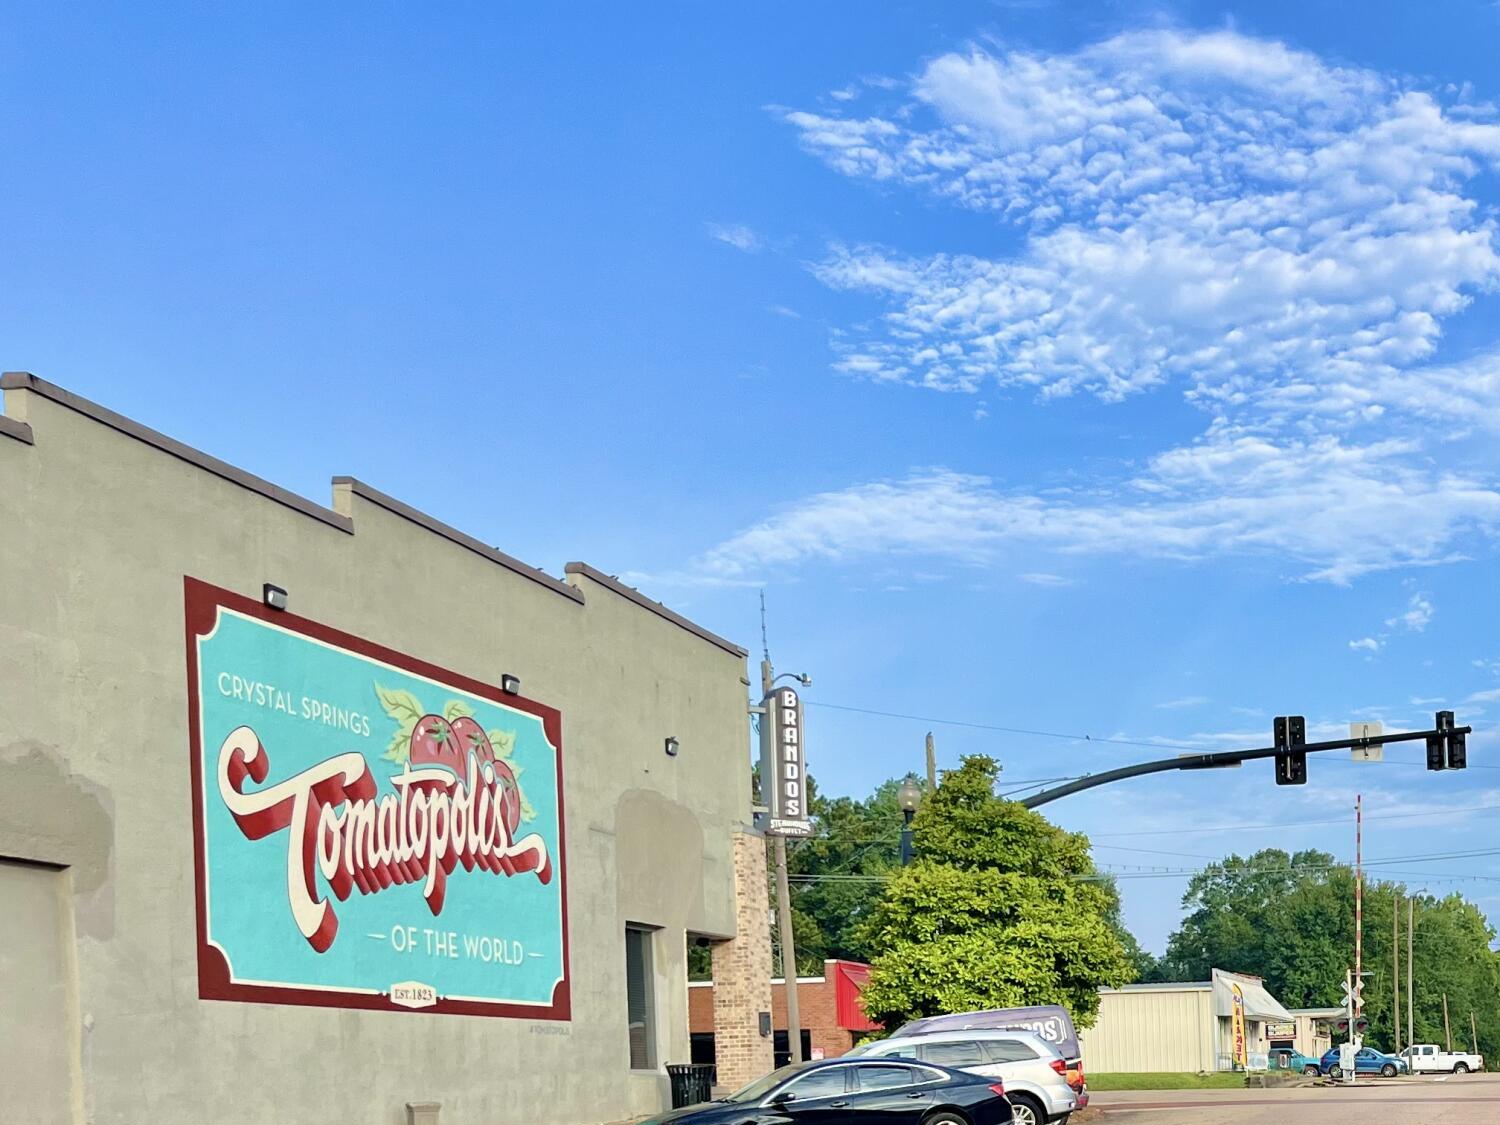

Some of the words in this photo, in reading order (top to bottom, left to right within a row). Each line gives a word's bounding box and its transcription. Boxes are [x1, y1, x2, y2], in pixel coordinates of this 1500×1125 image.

[218, 672, 297, 716] CRYSTAL
[302, 697, 370, 737] SPRINGS
[781, 690, 800, 816] BRANDOS
[217, 726, 552, 952] Tomatopolis
[391, 924, 417, 952] OF
[423, 929, 459, 958] THE
[463, 934, 523, 965] WORLD
